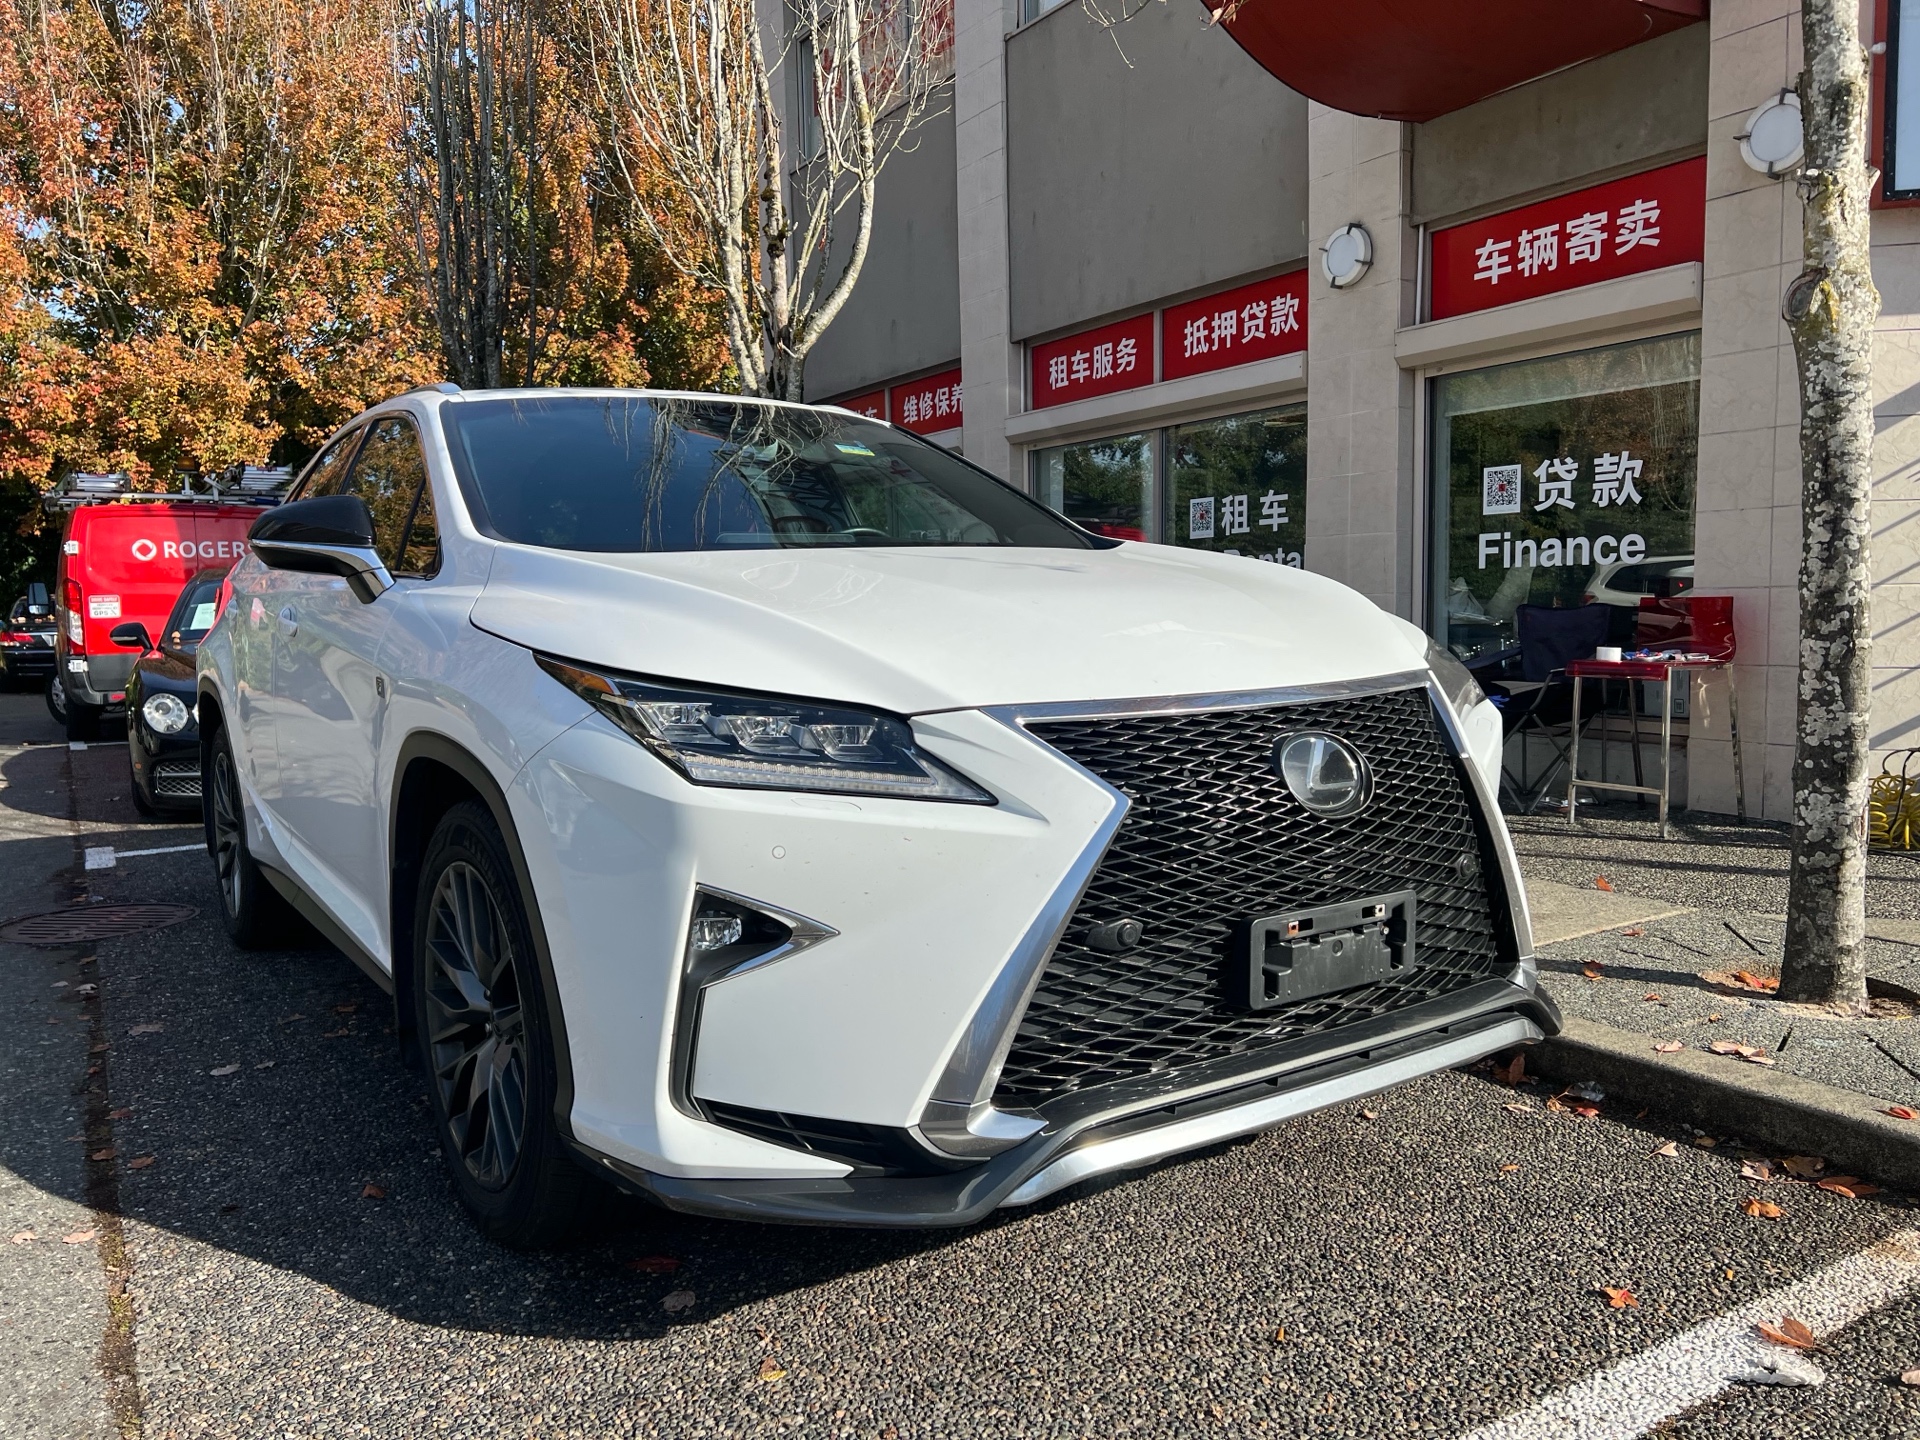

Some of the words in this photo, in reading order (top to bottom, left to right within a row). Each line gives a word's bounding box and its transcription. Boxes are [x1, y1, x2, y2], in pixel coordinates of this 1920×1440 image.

[1474, 199, 1661, 285] 车辆寄卖
[1183, 293, 1300, 358] 抵押贷款
[1049, 337, 1138, 390] 租车服务
[1532, 450, 1644, 512] 贷款
[1221, 489, 1289, 536] 租车
[163, 541, 253, 559] ROGER
[1478, 531, 1646, 569] Finance
